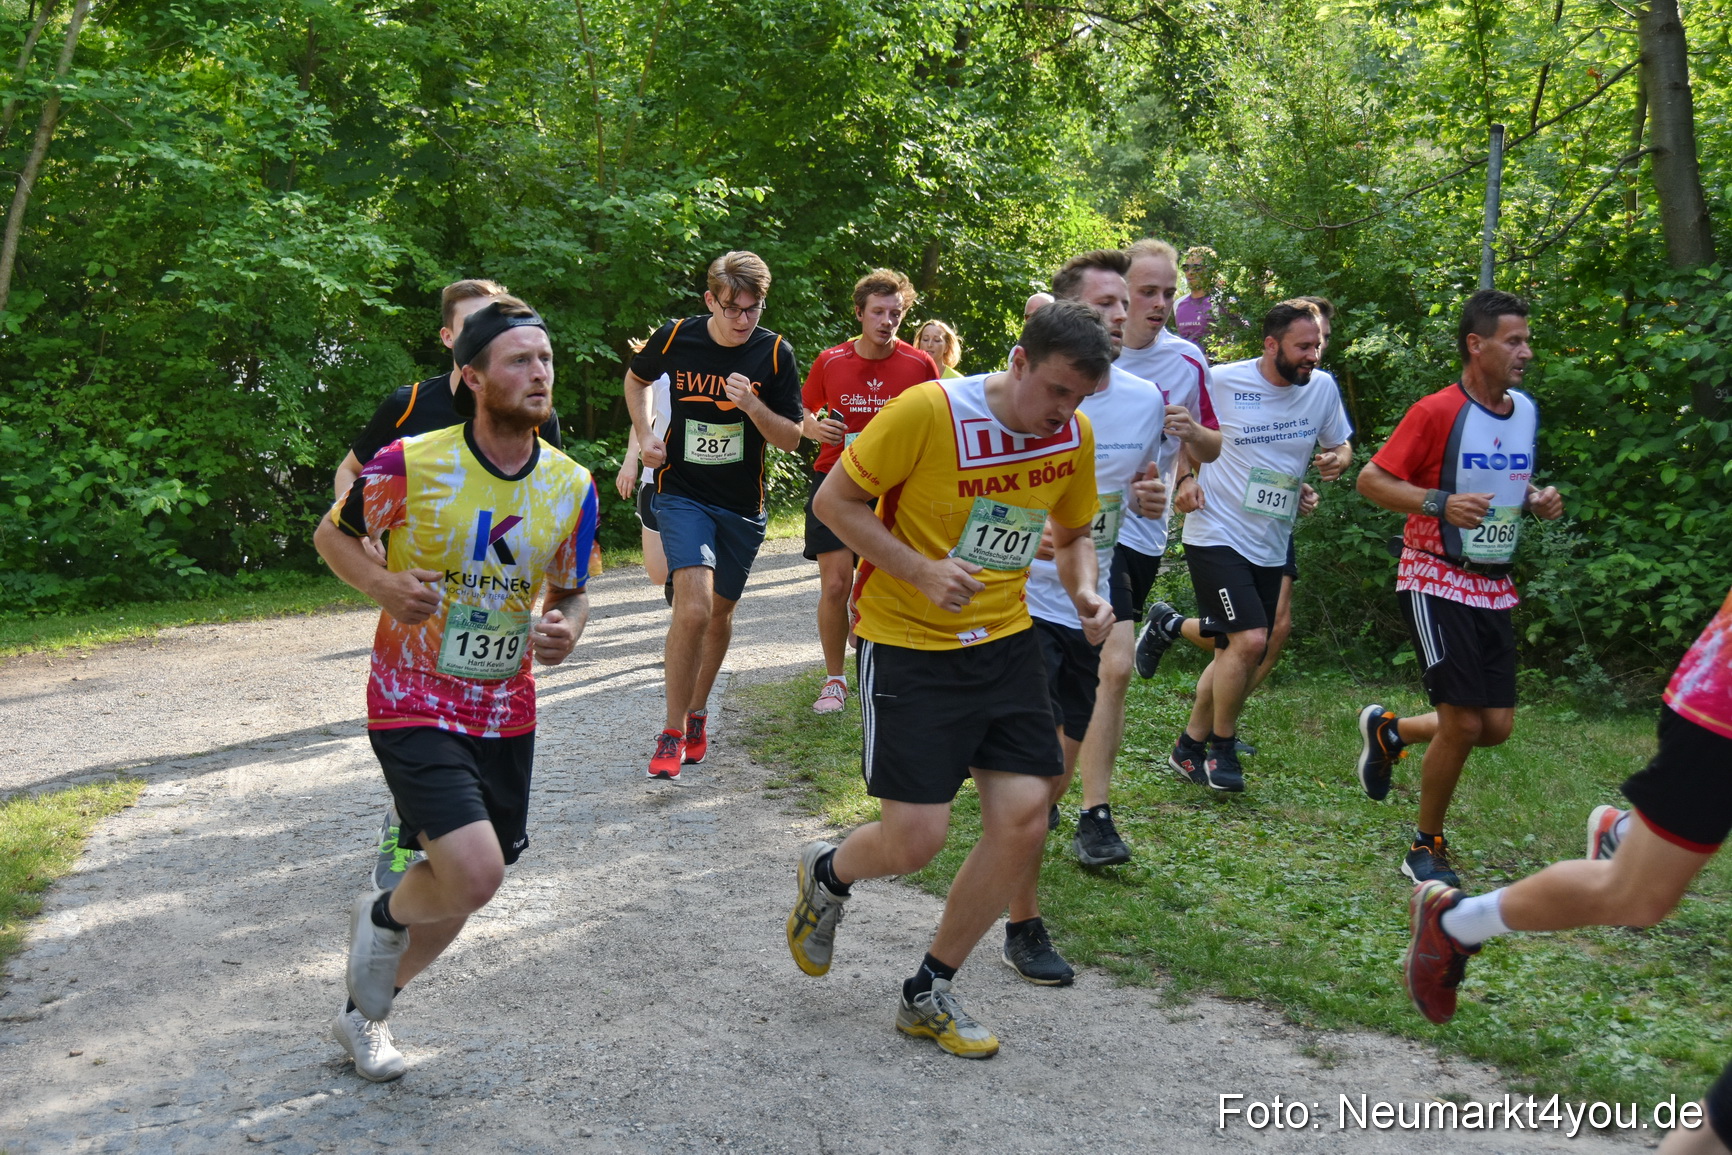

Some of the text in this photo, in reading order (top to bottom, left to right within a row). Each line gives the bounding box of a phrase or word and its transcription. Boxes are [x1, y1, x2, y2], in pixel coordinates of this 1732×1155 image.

[686, 371, 762, 398] WINS
[1234, 392, 1262, 402] DESS
[1243, 418, 1309, 434] Unser Sport ist
[696, 437, 731, 453] 287
[958, 460, 1076, 498] MAX BÖGL
[1256, 489, 1288, 509] 9131
[976, 524, 1032, 555] 1701
[1472, 524, 1516, 544] 2068
[444, 569, 531, 595] KÜFNER
[456, 631, 519, 661] 1319
[486, 660, 505, 668] Kevin
